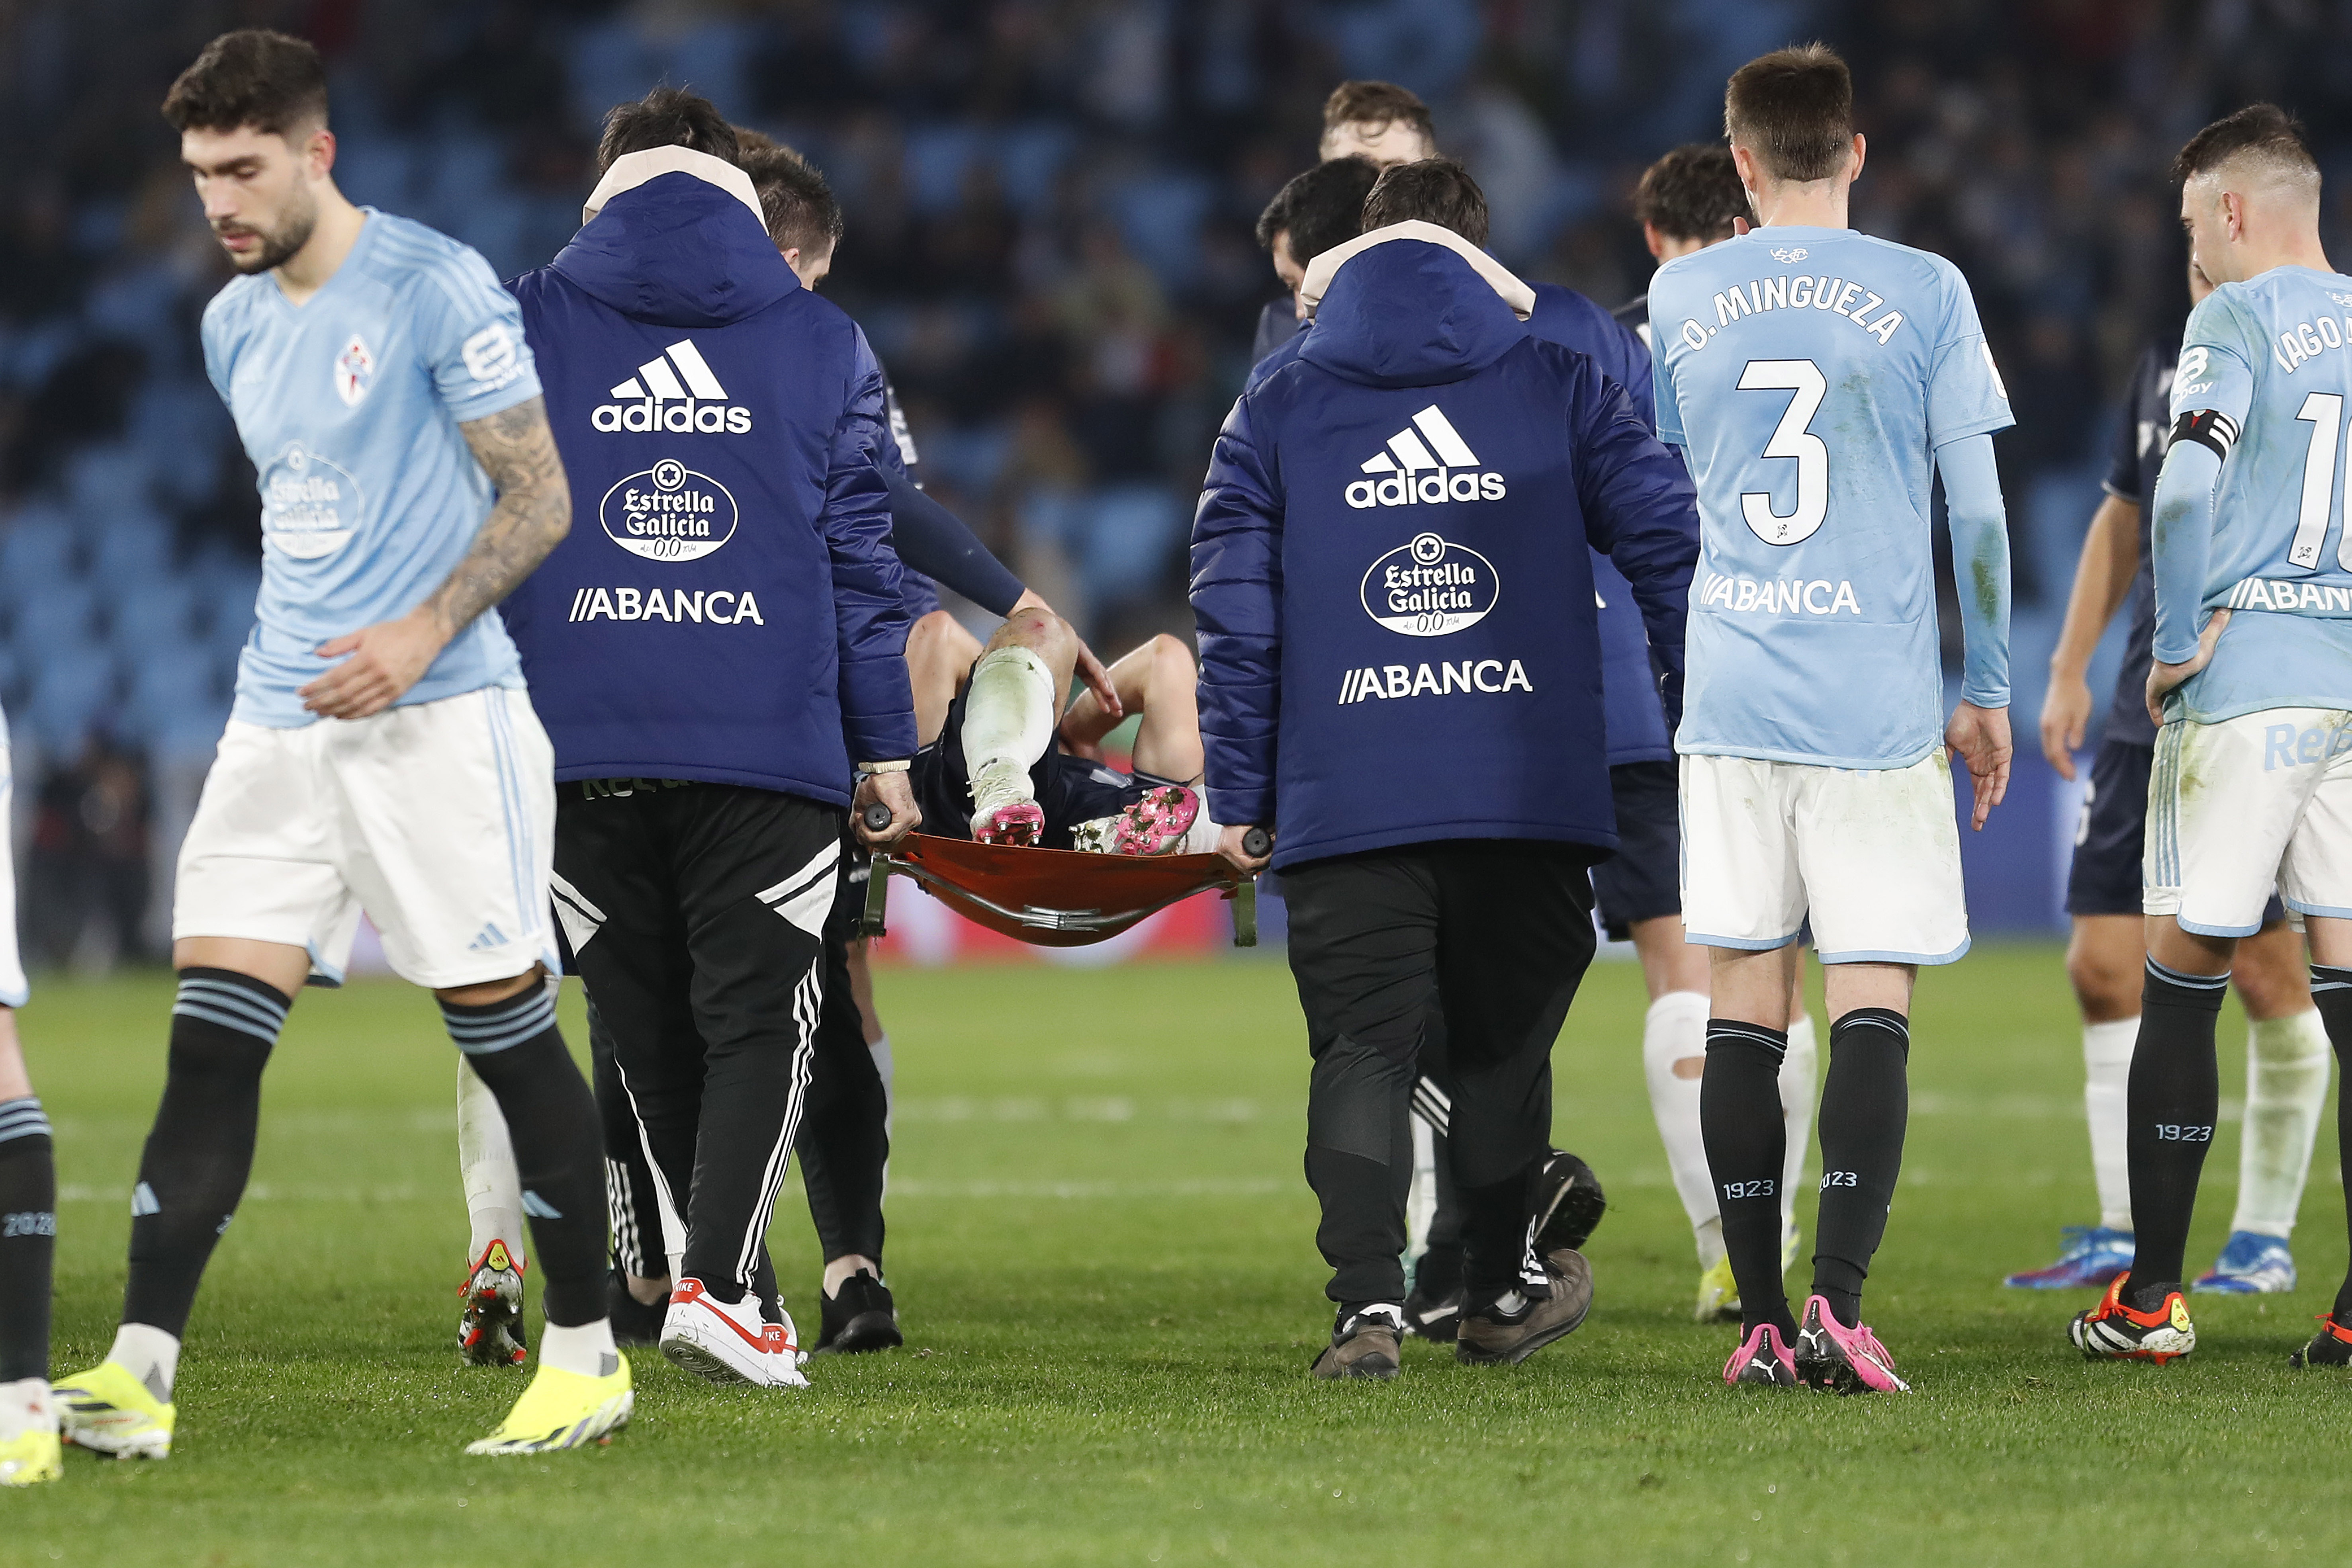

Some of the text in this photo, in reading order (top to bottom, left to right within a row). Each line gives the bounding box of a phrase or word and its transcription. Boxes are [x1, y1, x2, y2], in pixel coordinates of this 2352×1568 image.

[1712, 276, 1904, 346] MINGUEZA
[2274, 316, 2342, 374] IAGO
[592, 397, 751, 433] adidas
[1735, 359, 1829, 546] 3
[1345, 467, 1506, 508] adidas
[623, 488, 714, 513] Estrella
[626, 512, 710, 536] Galicia
[654, 539, 681, 557] 0,0
[1384, 563, 1476, 588] Estrella
[1389, 588, 1472, 612] Galicia
[1417, 612, 1444, 632] 0,0
[2156, 1124, 2212, 1142] 1923
[1723, 1180, 1774, 1200] 1923
